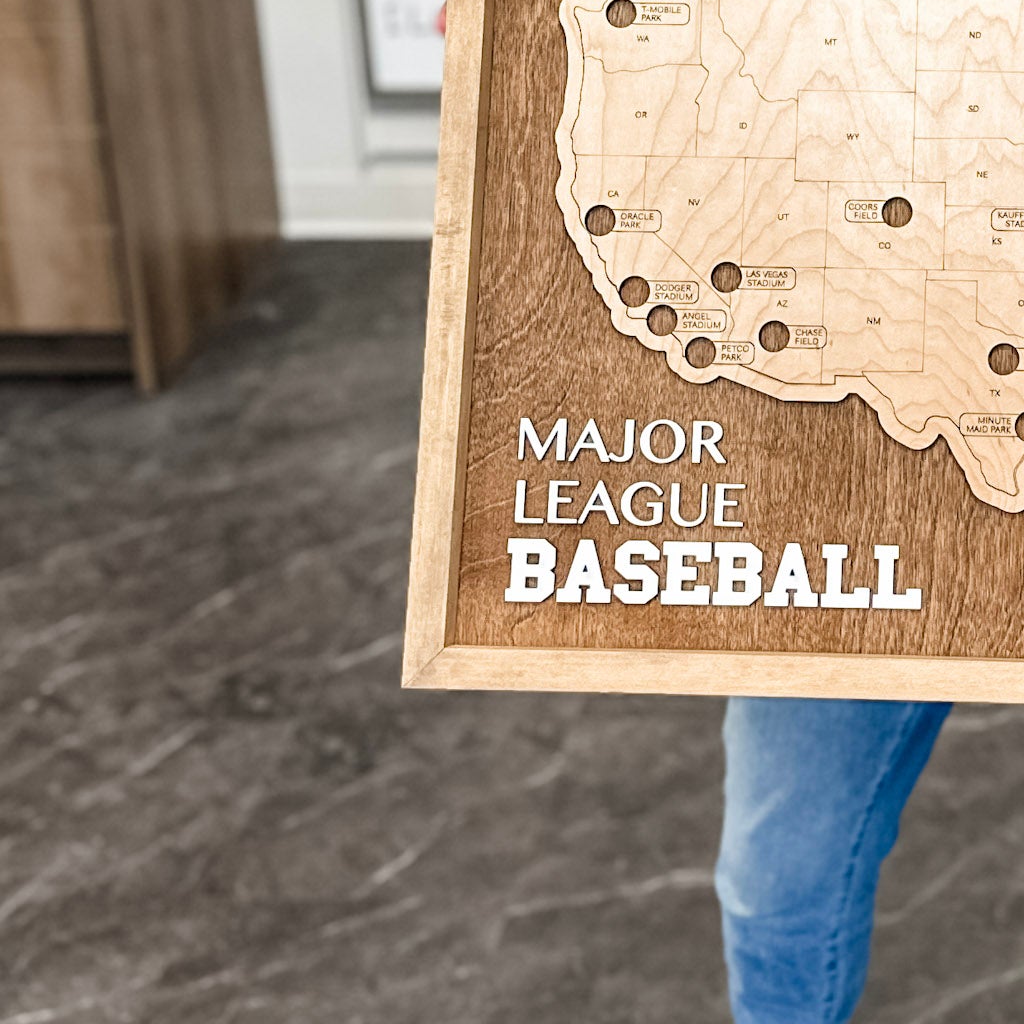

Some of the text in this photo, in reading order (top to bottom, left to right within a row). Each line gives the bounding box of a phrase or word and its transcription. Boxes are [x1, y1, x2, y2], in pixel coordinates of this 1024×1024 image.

[641, 5, 681, 14] T-MOBILE
[635, 111, 647, 119] OR
[688, 199, 700, 207] NV
[848, 203, 878, 211] COORS
[620, 212, 654, 221] ORACLE
[777, 213, 789, 221] UT
[854, 212, 878, 220] FIELD
[620, 221, 641, 229] PARK
[991, 237, 1002, 245] KS
[878, 242, 891, 250] CO
[746, 270, 788, 279] LAS VEGAS
[747, 279, 786, 287] STADIUM
[655, 283, 691, 293] DODGER
[654, 292, 693, 301] STADIUM
[776, 300, 788, 308] AZ
[682, 312, 710, 320] ANGEL
[682, 321, 721, 329] STADIUM
[866, 317, 881, 325] NM
[795, 329, 823, 337] CHASE
[795, 337, 819, 345] FIELD
[721, 345, 749, 353] PETCO
[721, 353, 742, 361] PARK
[977, 417, 1011, 425] MINUTE
[966, 425, 1011, 434] MAID PARK
[517, 416, 727, 465] MAJOR
[514, 479, 746, 528] LEAGUE
[504, 538, 922, 610] BASEBALL
